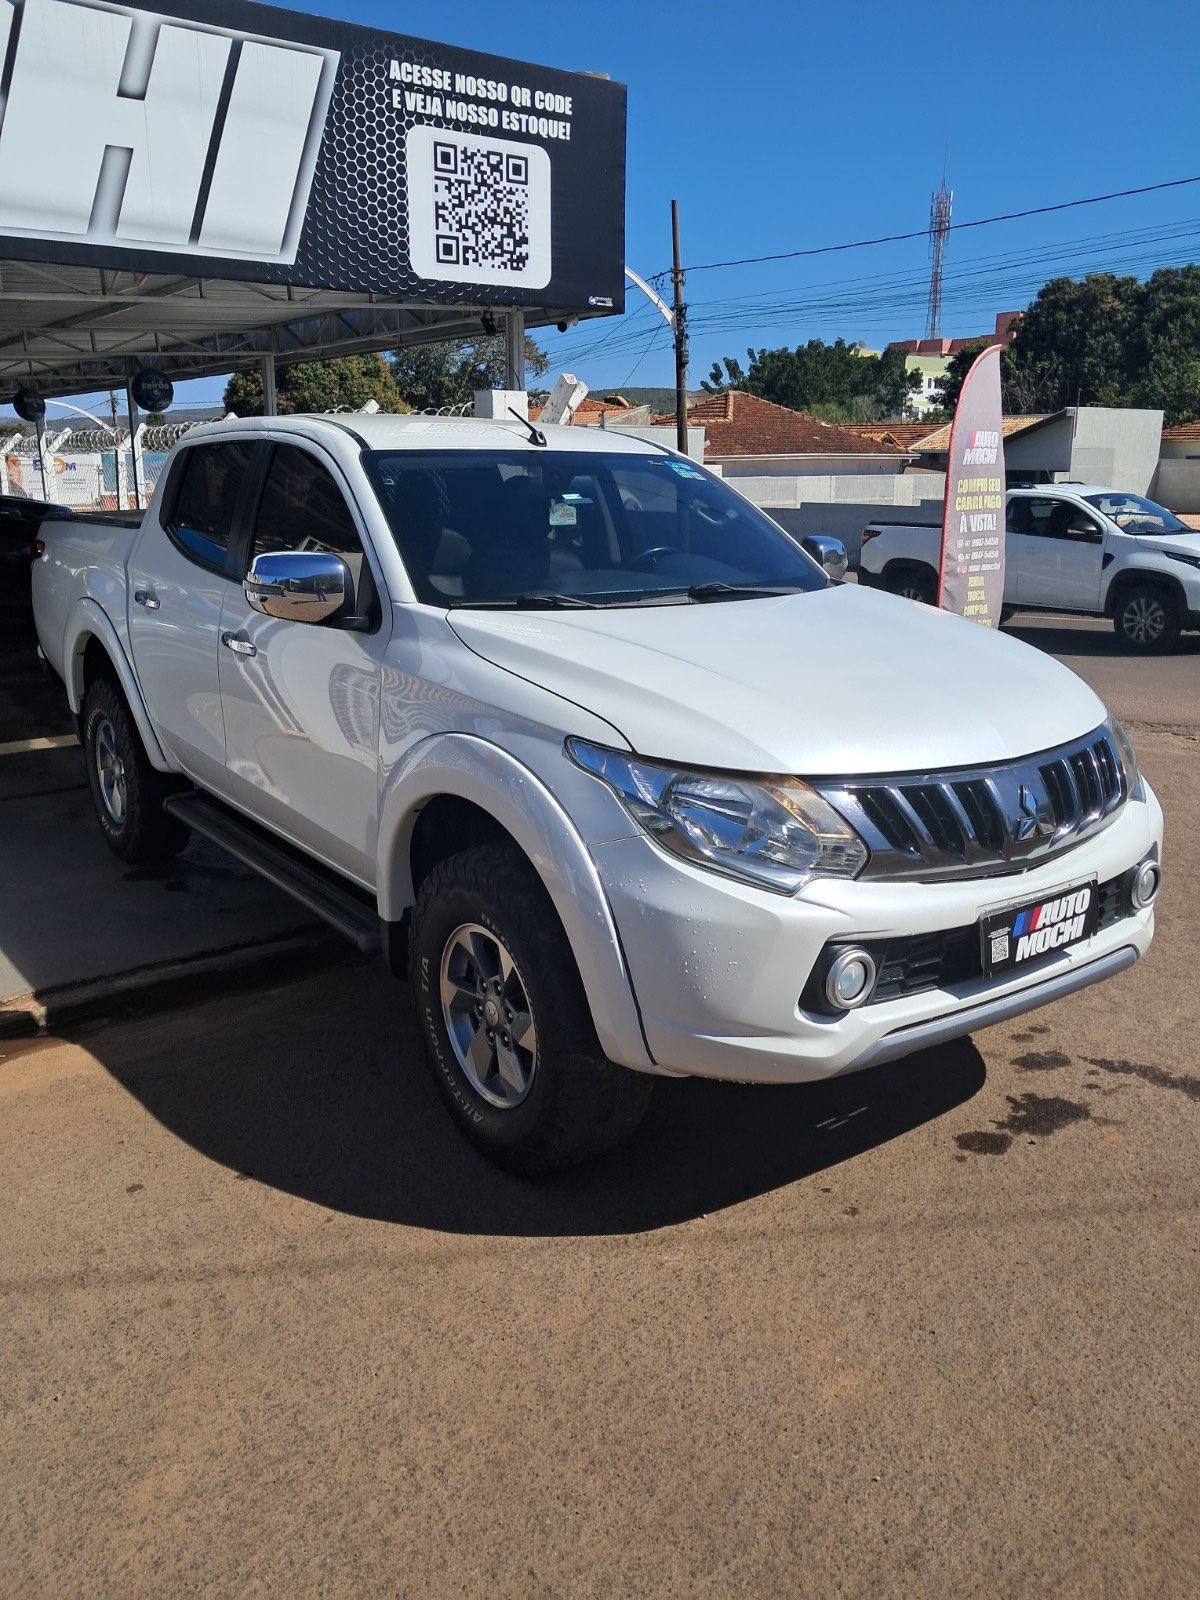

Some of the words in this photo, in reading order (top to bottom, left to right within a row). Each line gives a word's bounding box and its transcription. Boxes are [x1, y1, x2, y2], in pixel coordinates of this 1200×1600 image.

[389, 60, 451, 91] ACESSE
[454, 74, 507, 102] NOSSO
[511, 86, 531, 108] QR
[534, 90, 573, 116] CODE
[0, 0, 328, 257] HI
[392, 88, 401, 109] E
[404, 91, 444, 116] VEJA
[446, 100, 499, 127] NOSSO
[502, 113, 571, 140] ESTOQUE!
[974, 431, 999, 448] AUTO
[962, 448, 997, 466] MOCHI
[988, 478, 1001, 493] SEU
[983, 495, 1002, 510] PAGO
[959, 512, 968, 533] À
[969, 513, 997, 532] VISTA!
[1035, 888, 1091, 930] AUTO
[1015, 913, 1086, 962] MOCHI
